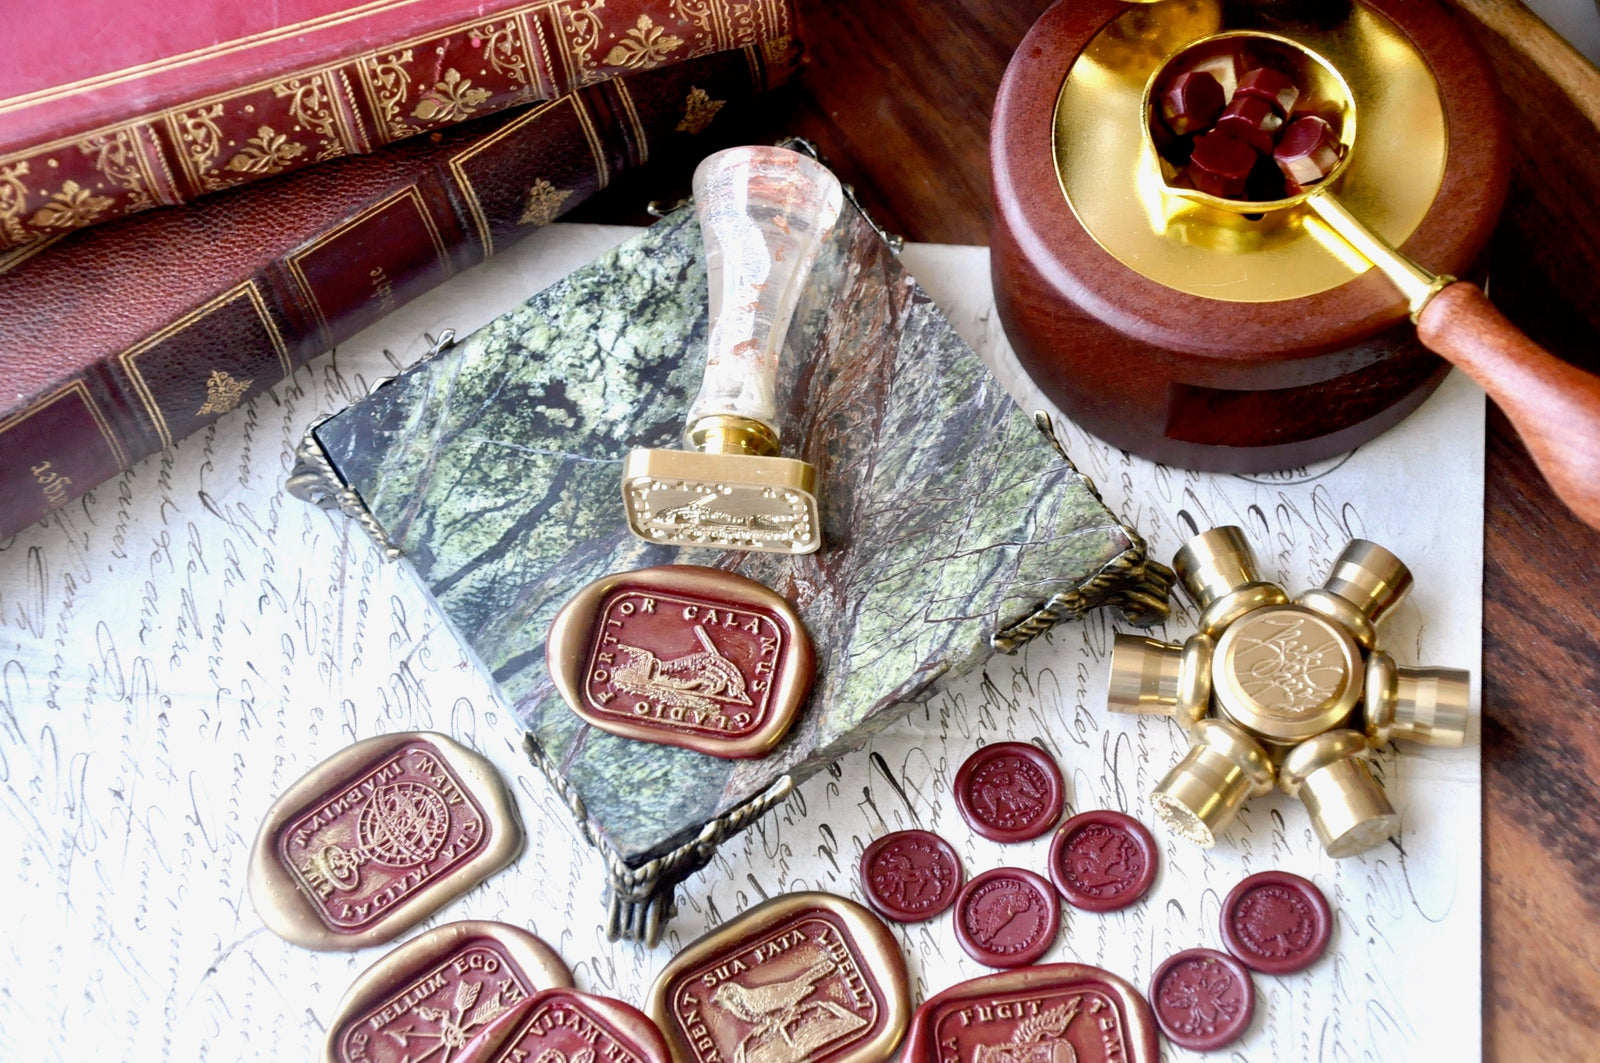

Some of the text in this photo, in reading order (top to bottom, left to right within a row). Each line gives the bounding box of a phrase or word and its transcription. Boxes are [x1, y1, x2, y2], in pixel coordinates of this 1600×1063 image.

[594, 597, 657, 704] FORTIOR
[683, 604, 777, 694] CALAMUS
[633, 701, 751, 731] GLADIO
[369, 975, 448, 1030] BELLUM
[454, 956, 498, 974] EGO
[702, 960, 748, 988] SUA
[753, 929, 807, 964] FATA
[816, 927, 874, 1011] LIBELLI
[529, 1011, 600, 1044] VITAM
[959, 1000, 1045, 1027] FUGIT
